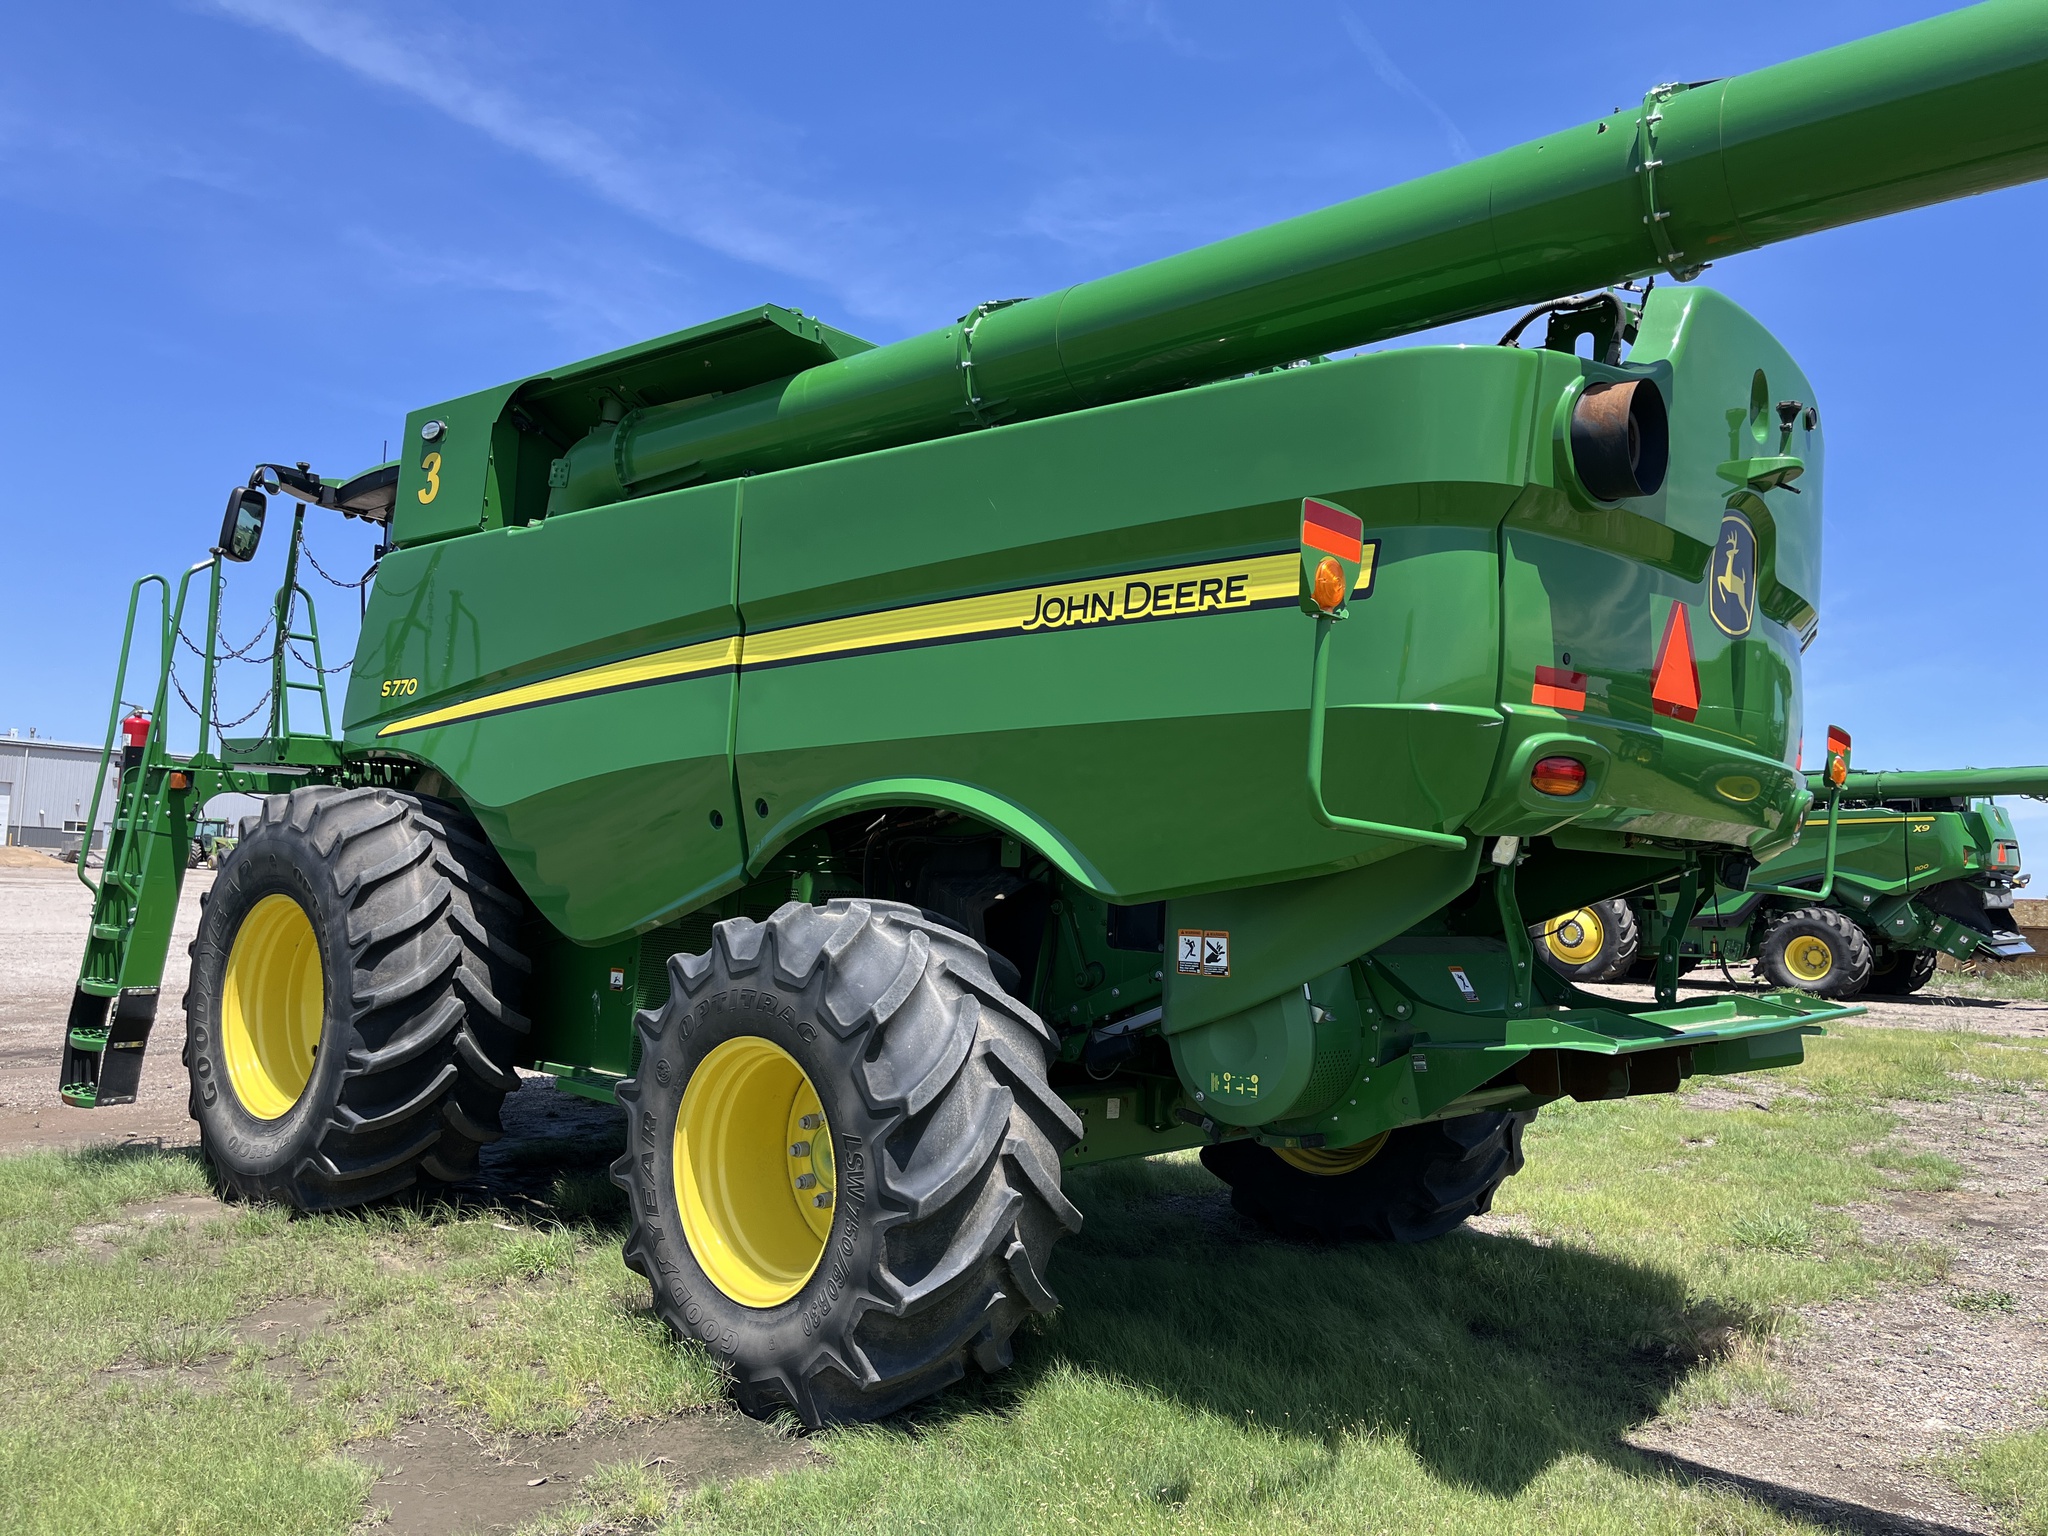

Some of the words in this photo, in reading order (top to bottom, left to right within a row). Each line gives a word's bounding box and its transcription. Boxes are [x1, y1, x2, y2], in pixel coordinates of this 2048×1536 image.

[417, 451, 442, 505] 3
[1022, 590, 1115, 628] JOHN
[1122, 573, 1249, 617] DEERE
[381, 677, 418, 698] S770
[1912, 824, 1931, 833] X9
[678, 987, 818, 1044] OPTITRAC
[641, 1110, 740, 1355] GOODYEAR
